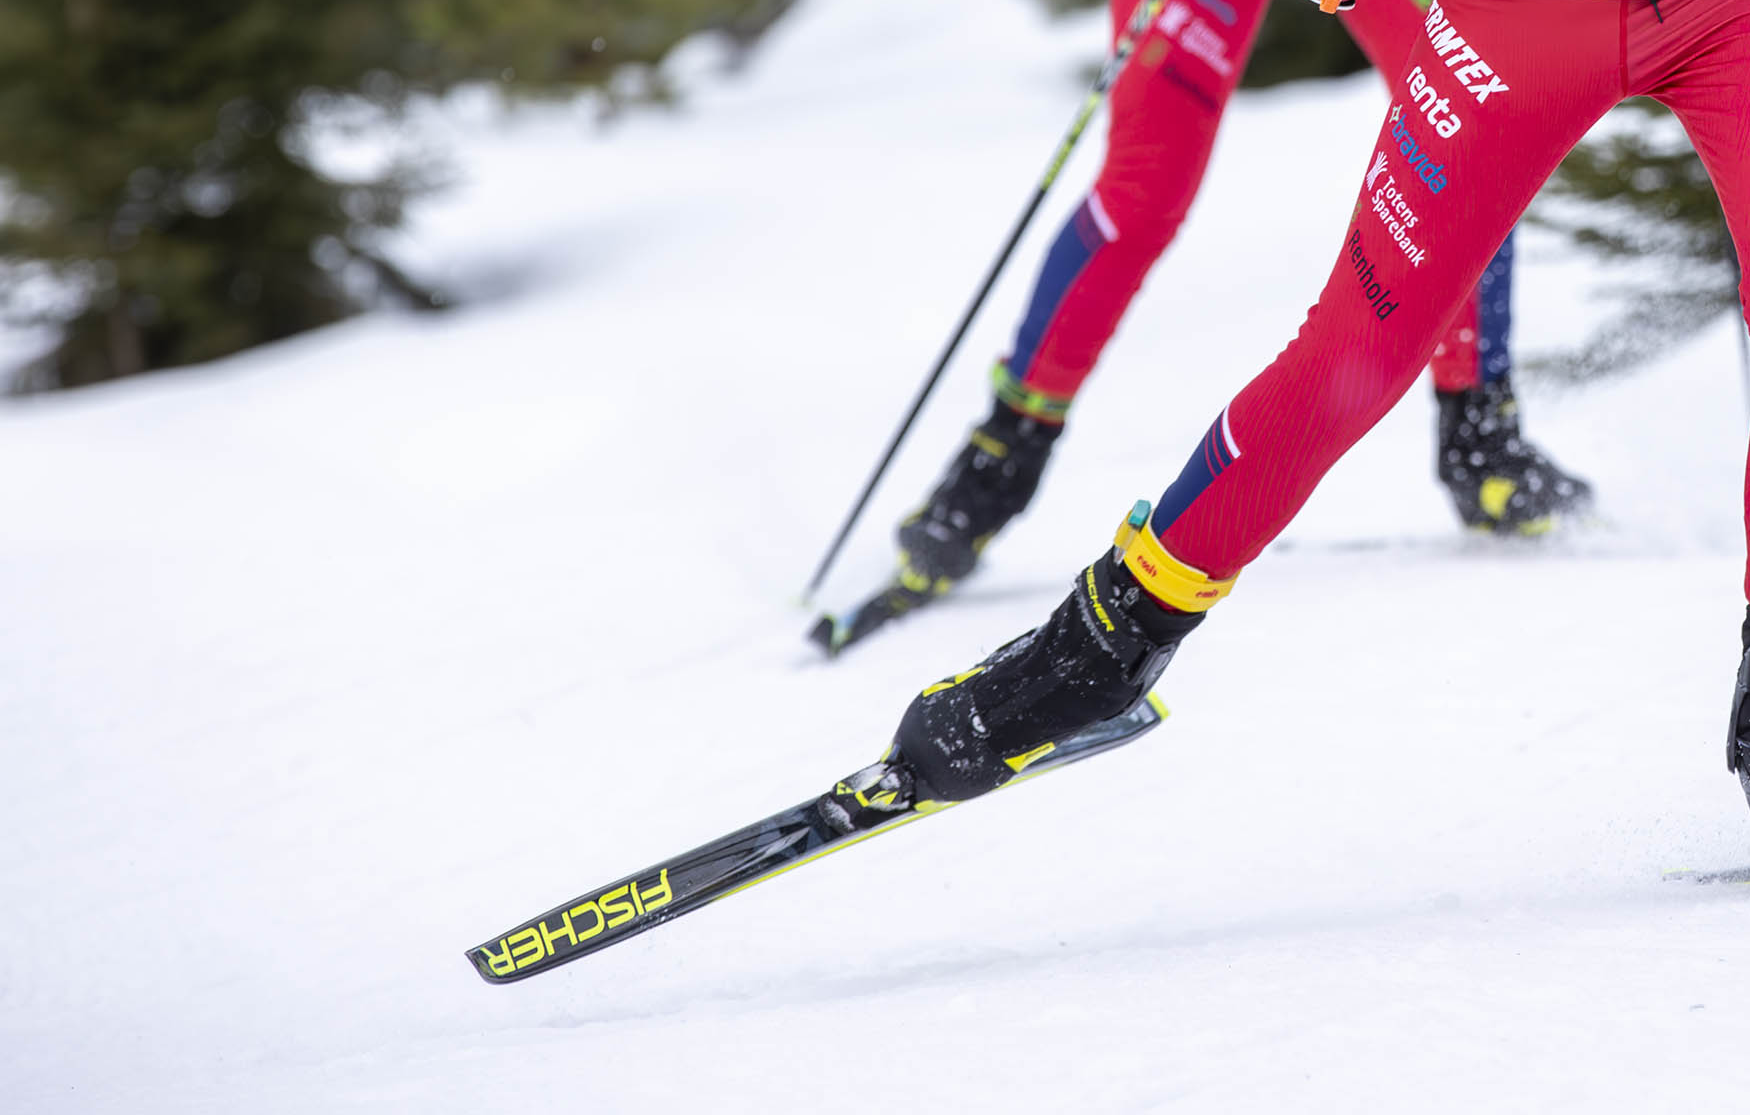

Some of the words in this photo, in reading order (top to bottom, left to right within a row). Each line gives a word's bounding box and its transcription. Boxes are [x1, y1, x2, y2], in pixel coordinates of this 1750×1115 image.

[1406, 66, 1462, 139] renta
[1391, 113, 1448, 195] bravida
[1371, 188, 1426, 268] Sparebank
[1382, 175, 1419, 229] Totens
[1348, 229, 1399, 322] Renhold
[479, 868, 673, 976] FISCHER
